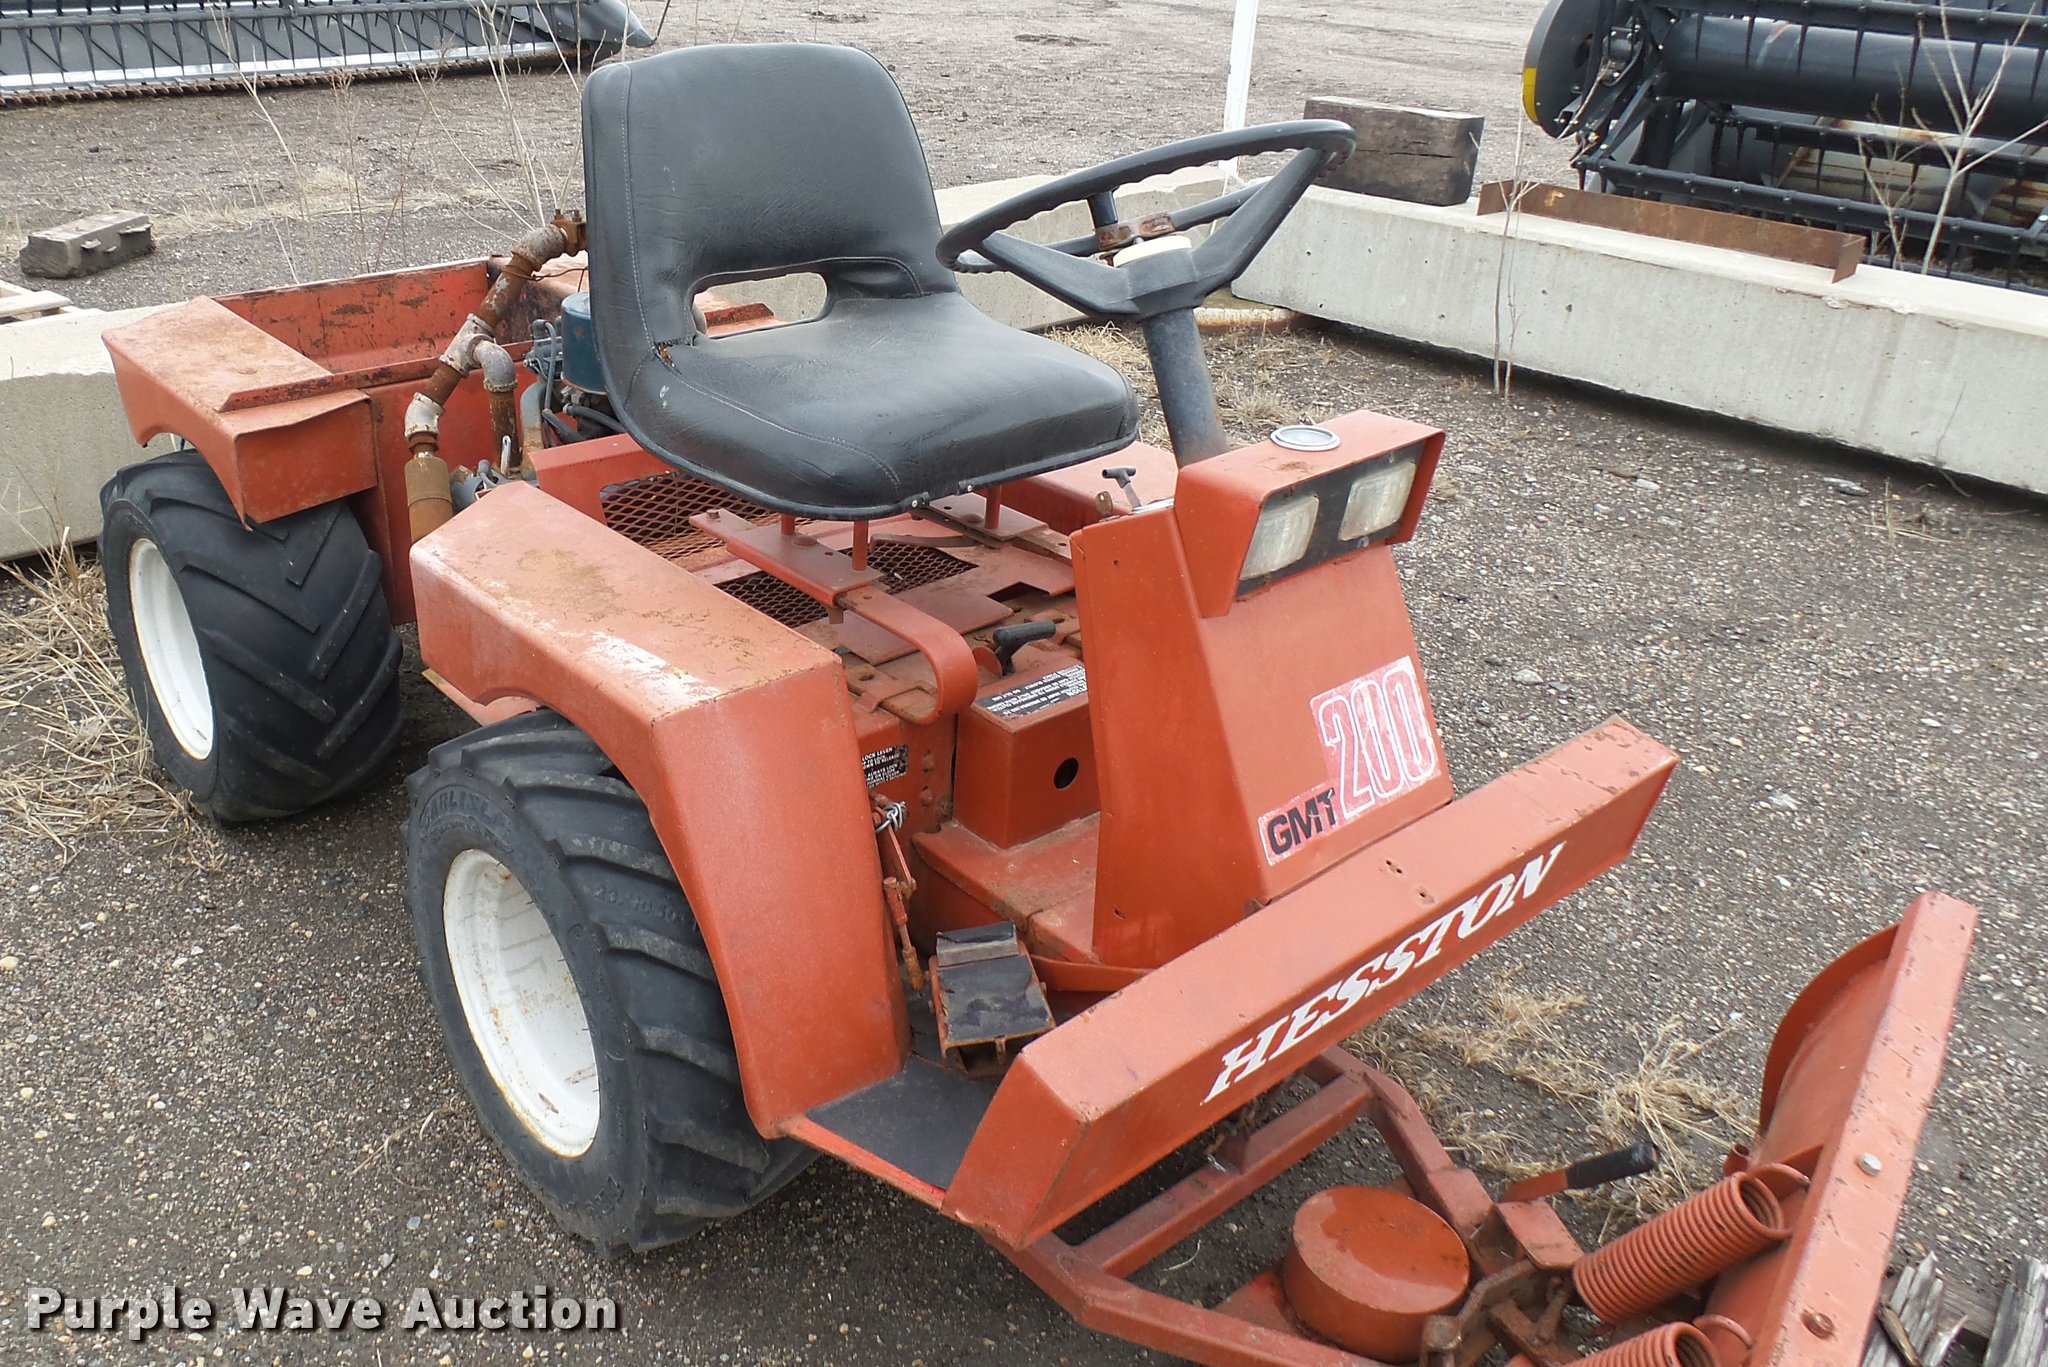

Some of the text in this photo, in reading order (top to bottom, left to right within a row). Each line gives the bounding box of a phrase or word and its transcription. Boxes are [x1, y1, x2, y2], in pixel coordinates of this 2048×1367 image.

[1267, 669, 1435, 855] GMT 200
[1201, 841, 1567, 1105] HESSTON
